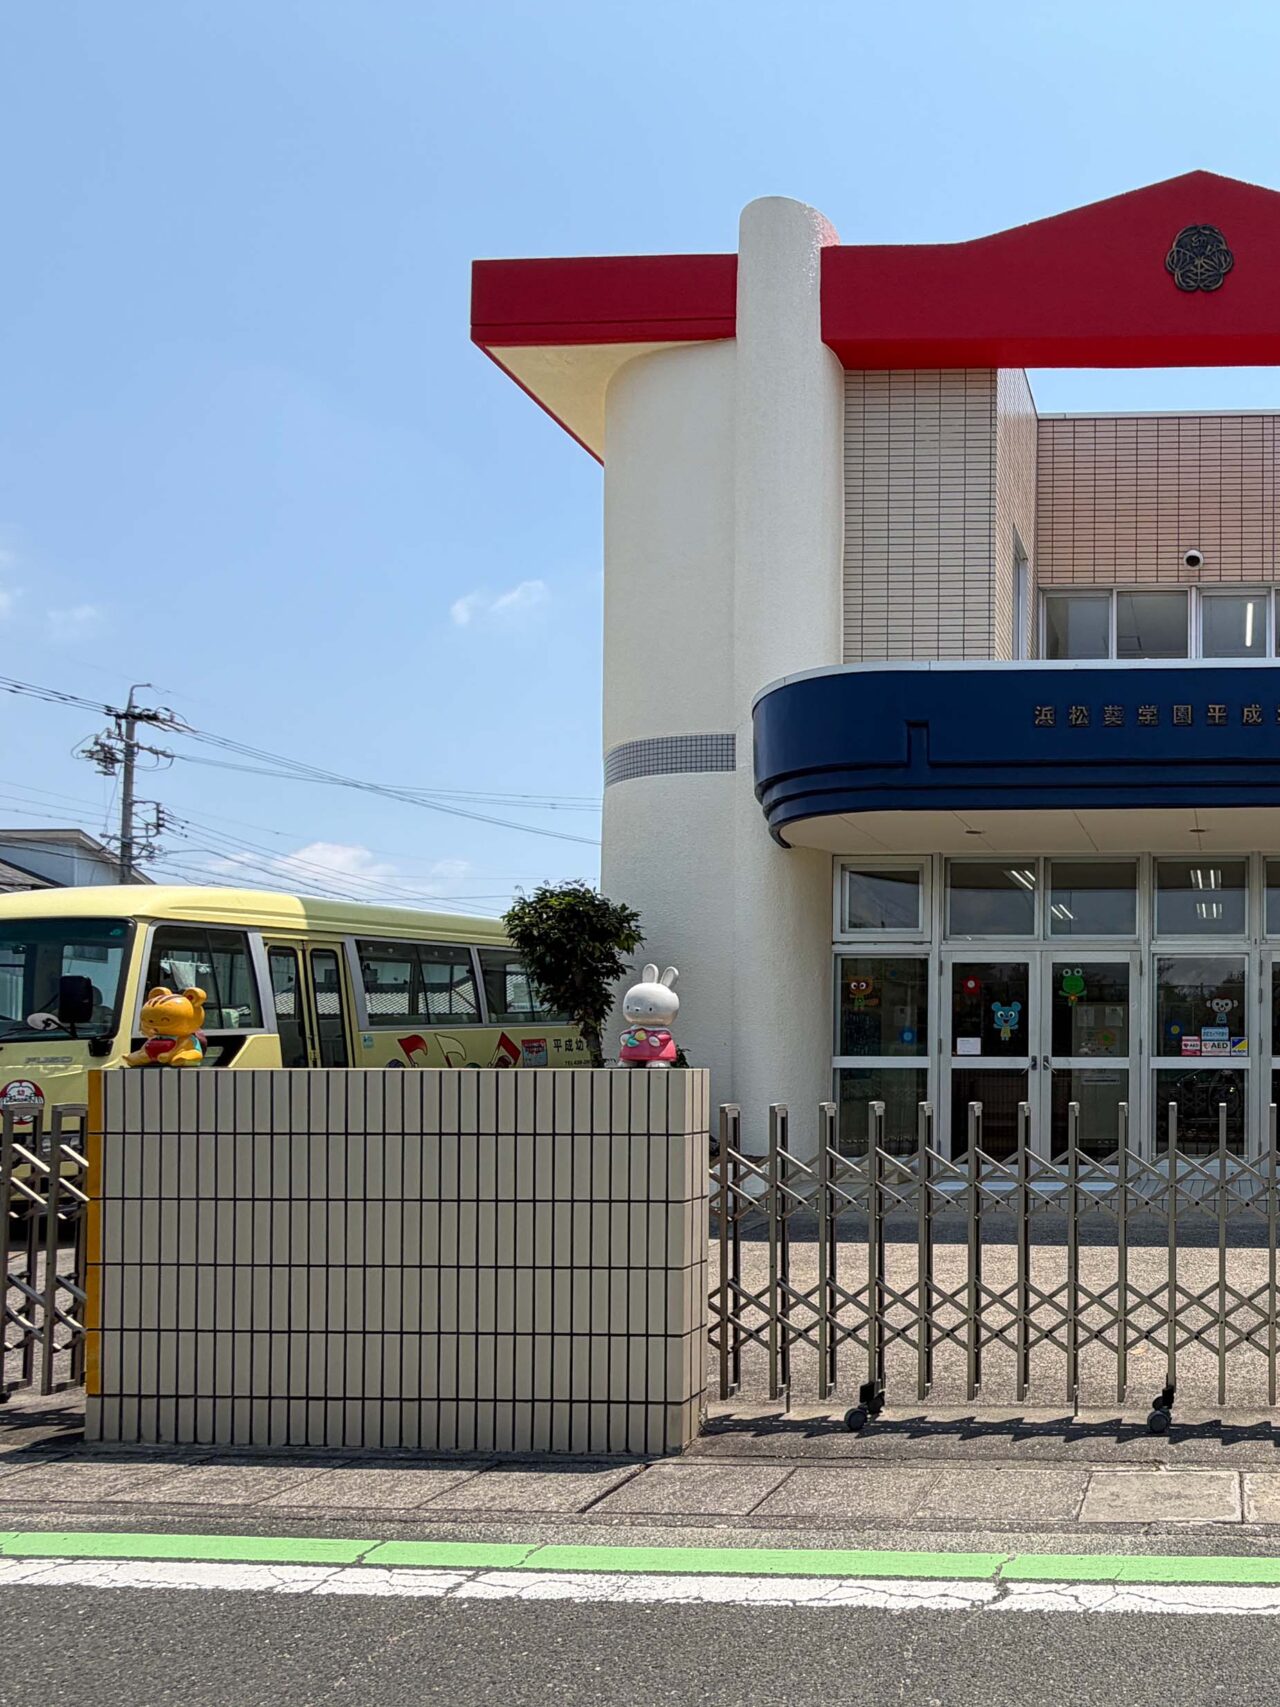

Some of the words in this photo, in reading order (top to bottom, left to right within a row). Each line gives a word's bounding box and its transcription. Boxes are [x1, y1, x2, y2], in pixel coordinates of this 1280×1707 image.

[552, 1037, 587, 1053] 平成幼
[1210, 1042, 1229, 1050] AED
